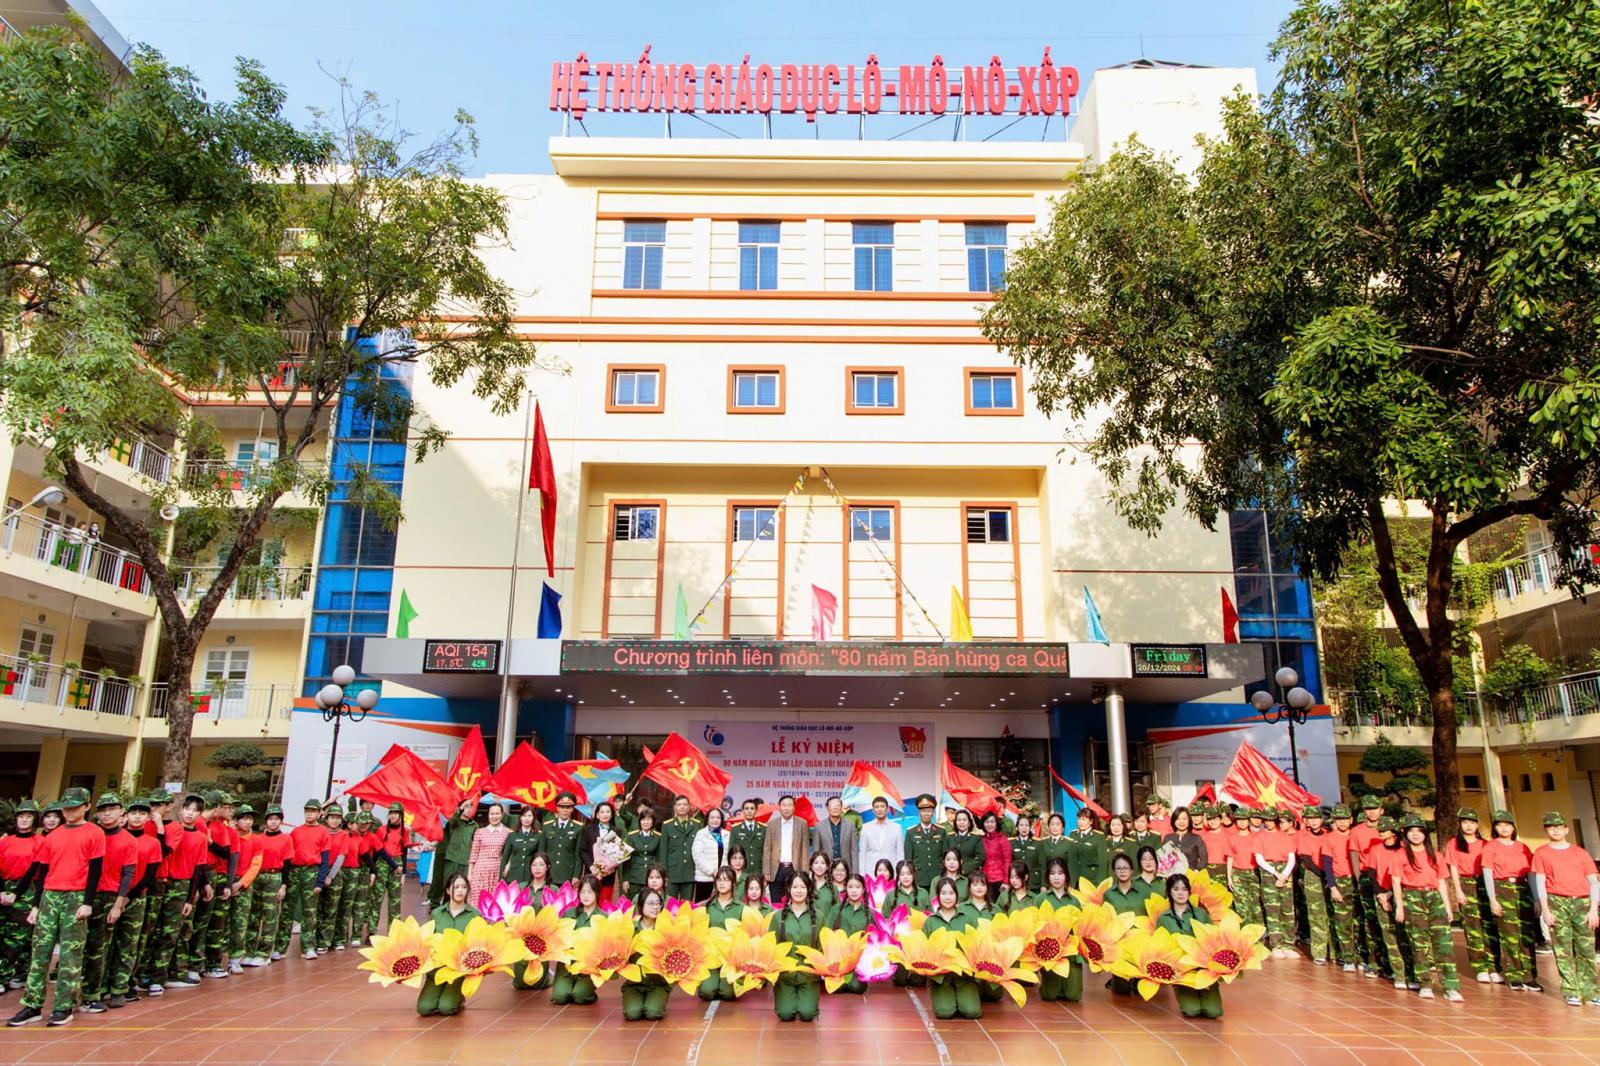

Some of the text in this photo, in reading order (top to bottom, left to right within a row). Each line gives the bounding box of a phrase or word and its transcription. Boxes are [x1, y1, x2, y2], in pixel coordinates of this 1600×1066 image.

[550, 51, 589, 120] HỆ
[596, 44, 697, 113] THỐNG
[703, 53, 774, 114] GIÁO
[780, 63, 841, 123] DỤC
[434, 644, 489, 658] AQI 154
[1145, 650, 1192, 664] Friday
[471, 658, 488, 668] 45%
[613, 647, 691, 669] Chương
[695, 648, 737, 666] trình
[742, 648, 774, 666] liên
[779, 649, 825, 666] môn:
[831, 647, 861, 667] "80
[866, 649, 907, 667] năm
[913, 647, 950, 667] Bản
[955, 649, 1000, 671] hùng
[1006, 653, 1028, 668] ca
[1138, 663, 1181, 672] 20/12/2024
[771, 735, 854, 756] LỄ KỶ NIỆM
[723, 759, 731, 767] 80
[733, 758, 748, 767] NĂM
[750, 758, 766, 767] NGÀY
[769, 758, 789, 767] THÀNH
[791, 758, 803, 769] LẬP
[805, 758, 822, 768] QUÂN
[824, 758, 836, 769] ĐỘI
[871, 759, 885, 769] VIỆT
[887, 760, 901, 769] NAM
[746, 780, 754, 789] 35
[756, 779, 771, 789] NĂM
[773, 779, 789, 789] NGÀY
[791, 780, 802, 790] HỘI
[804, 778, 821, 789] QUỐC
